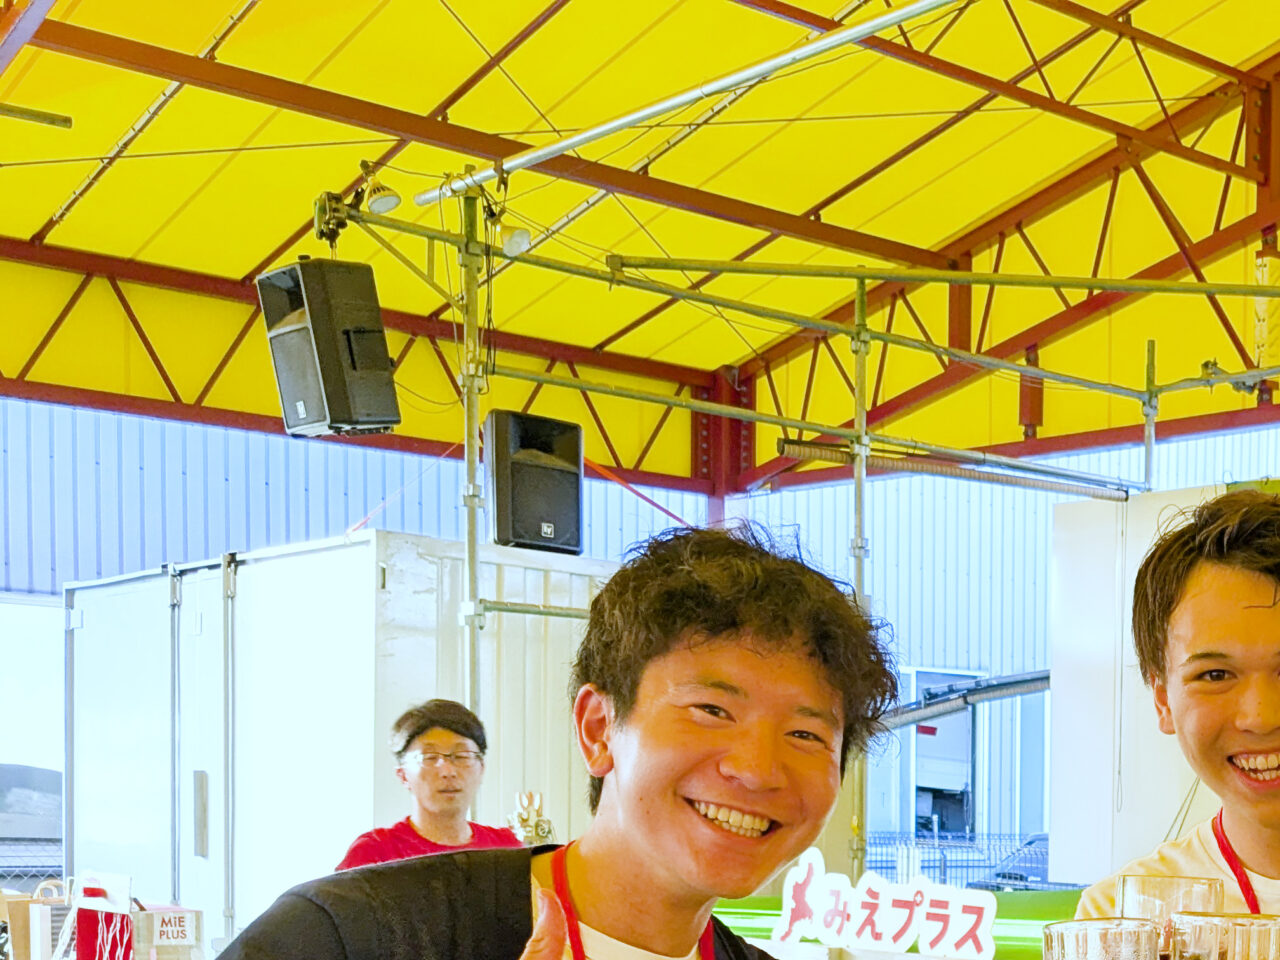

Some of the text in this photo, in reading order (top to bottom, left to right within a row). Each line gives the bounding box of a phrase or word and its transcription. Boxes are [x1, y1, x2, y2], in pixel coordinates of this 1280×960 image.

[159, 929, 187, 940] PLUS
[823, 887, 985, 955] みえプラス
